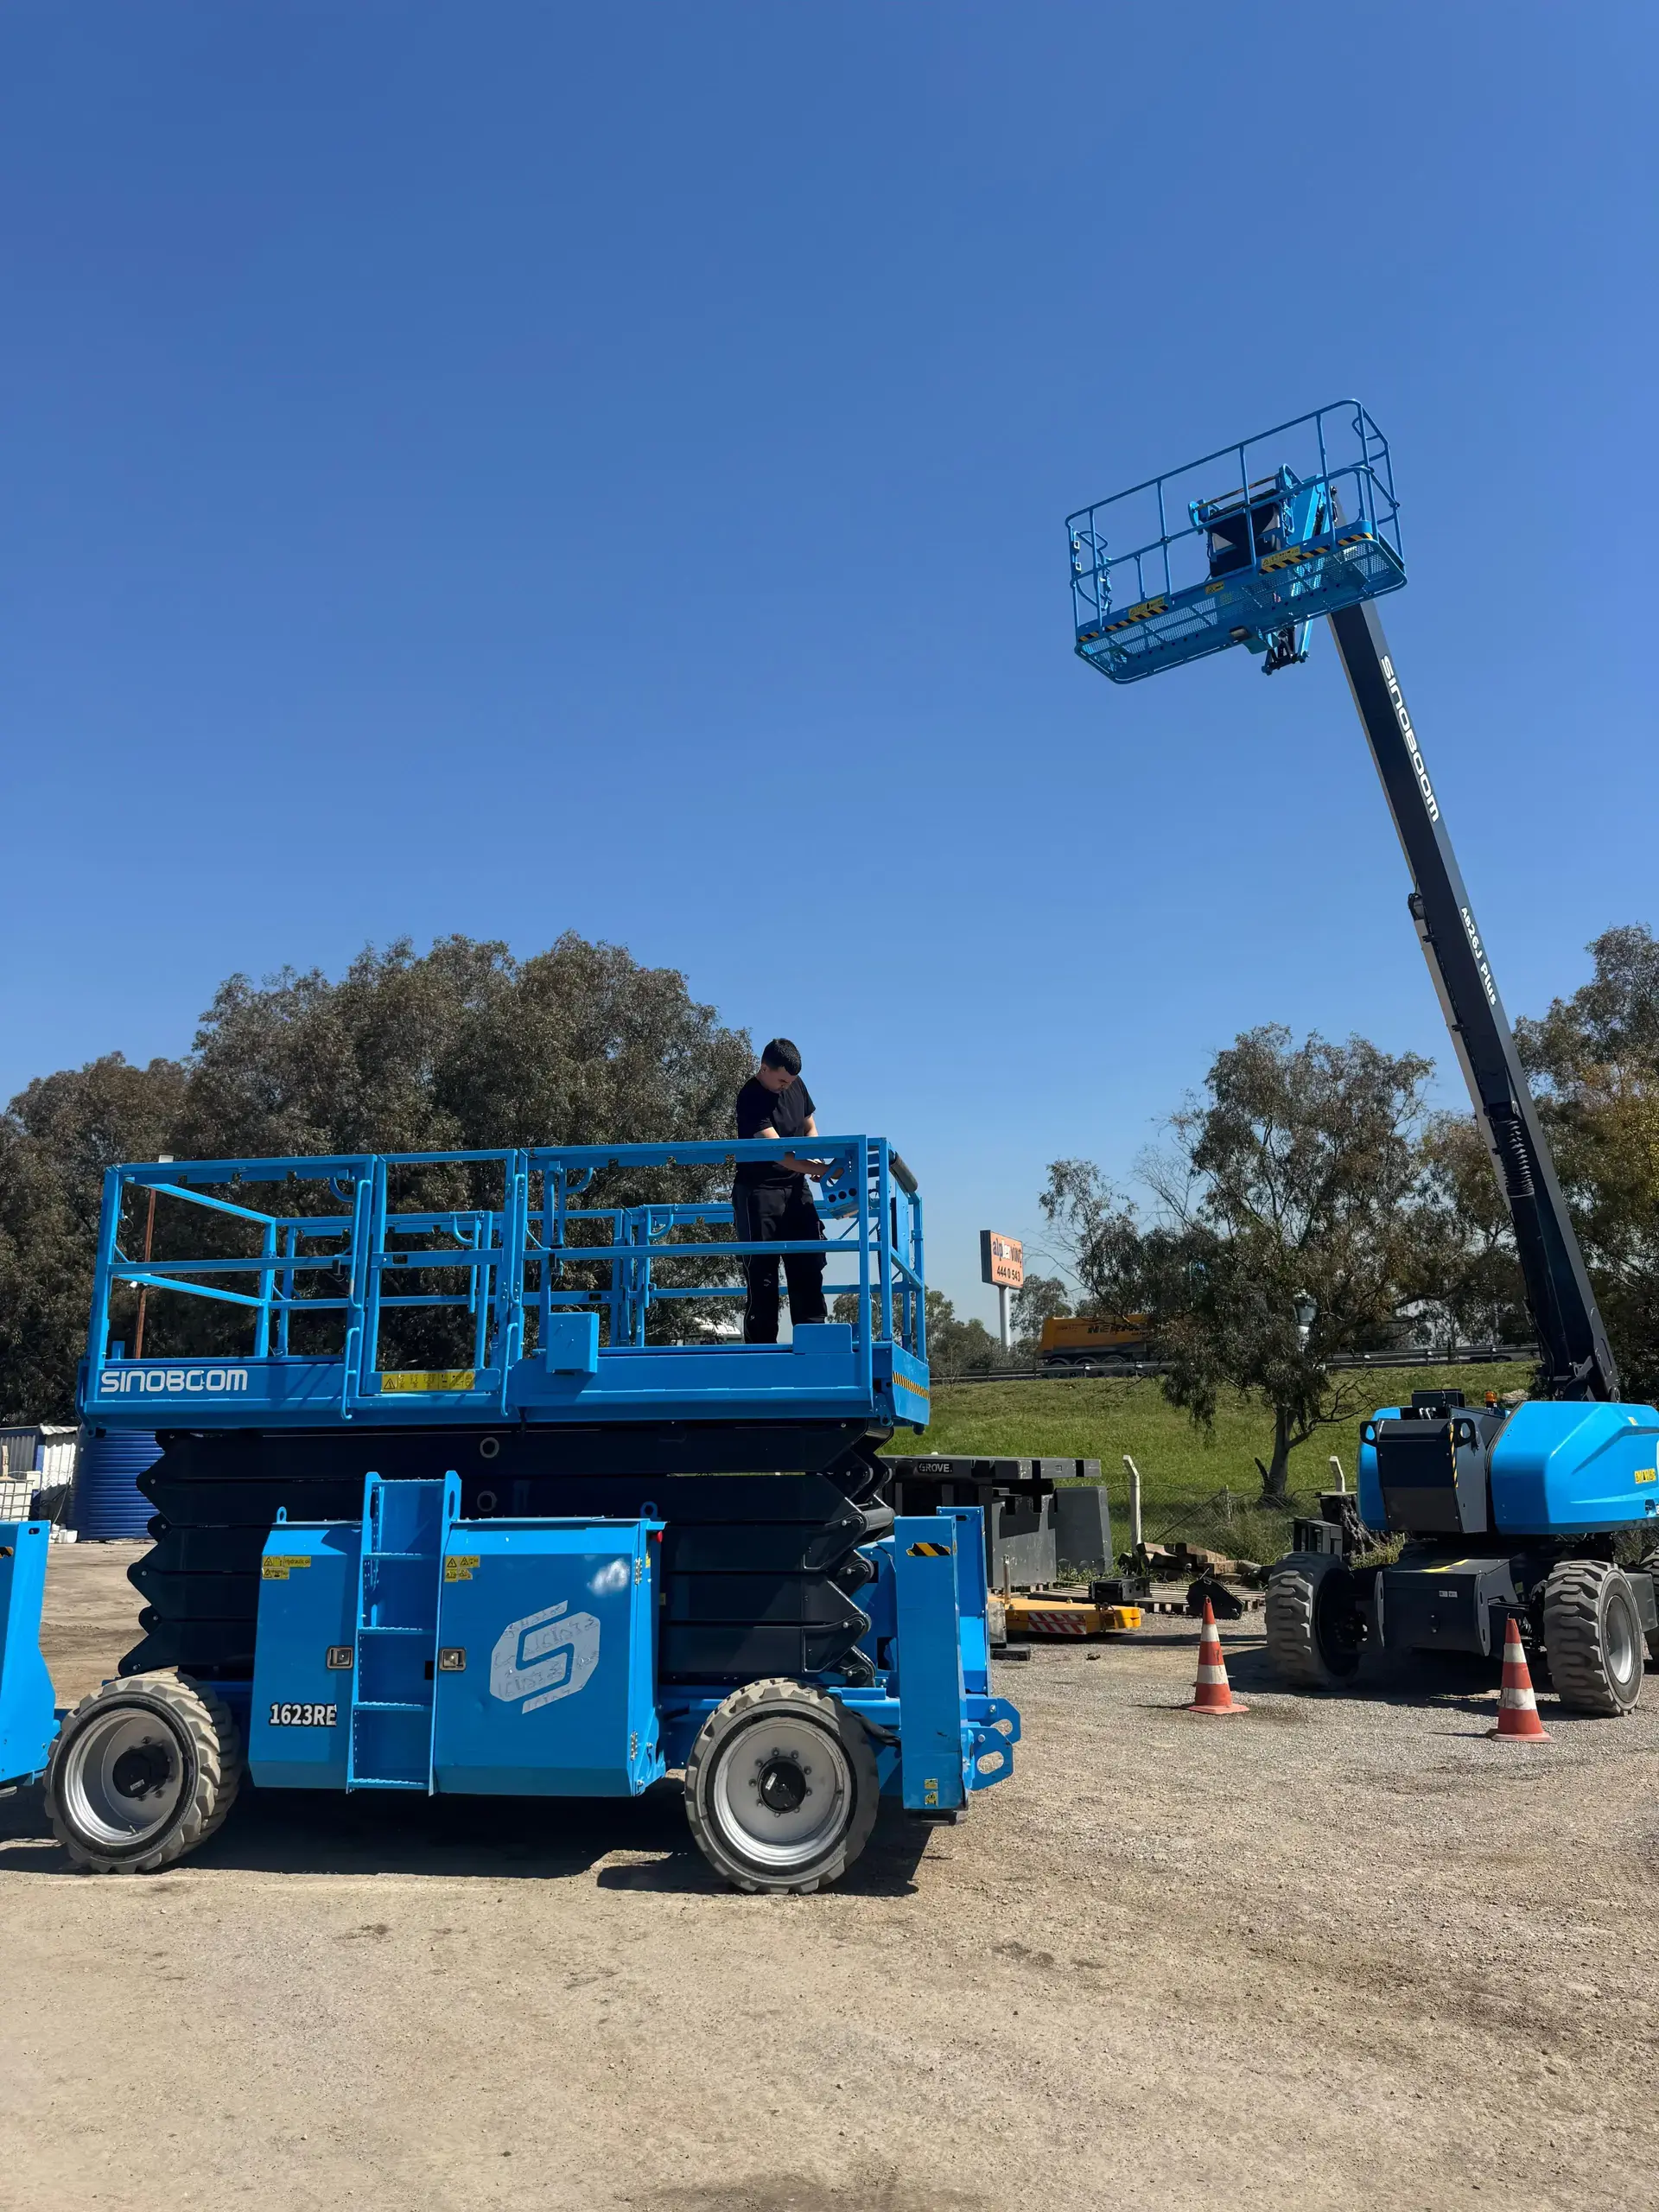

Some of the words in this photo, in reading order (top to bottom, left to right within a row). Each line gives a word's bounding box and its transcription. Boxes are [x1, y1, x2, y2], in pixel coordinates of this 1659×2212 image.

[1382, 655, 1440, 822] SINOBOOM
[1461, 907, 1483, 959] AB26J
[1480, 962, 1497, 1006] Plus
[996, 1265, 1007, 1277] 444
[270, 1703, 337, 1726] 1623RE
